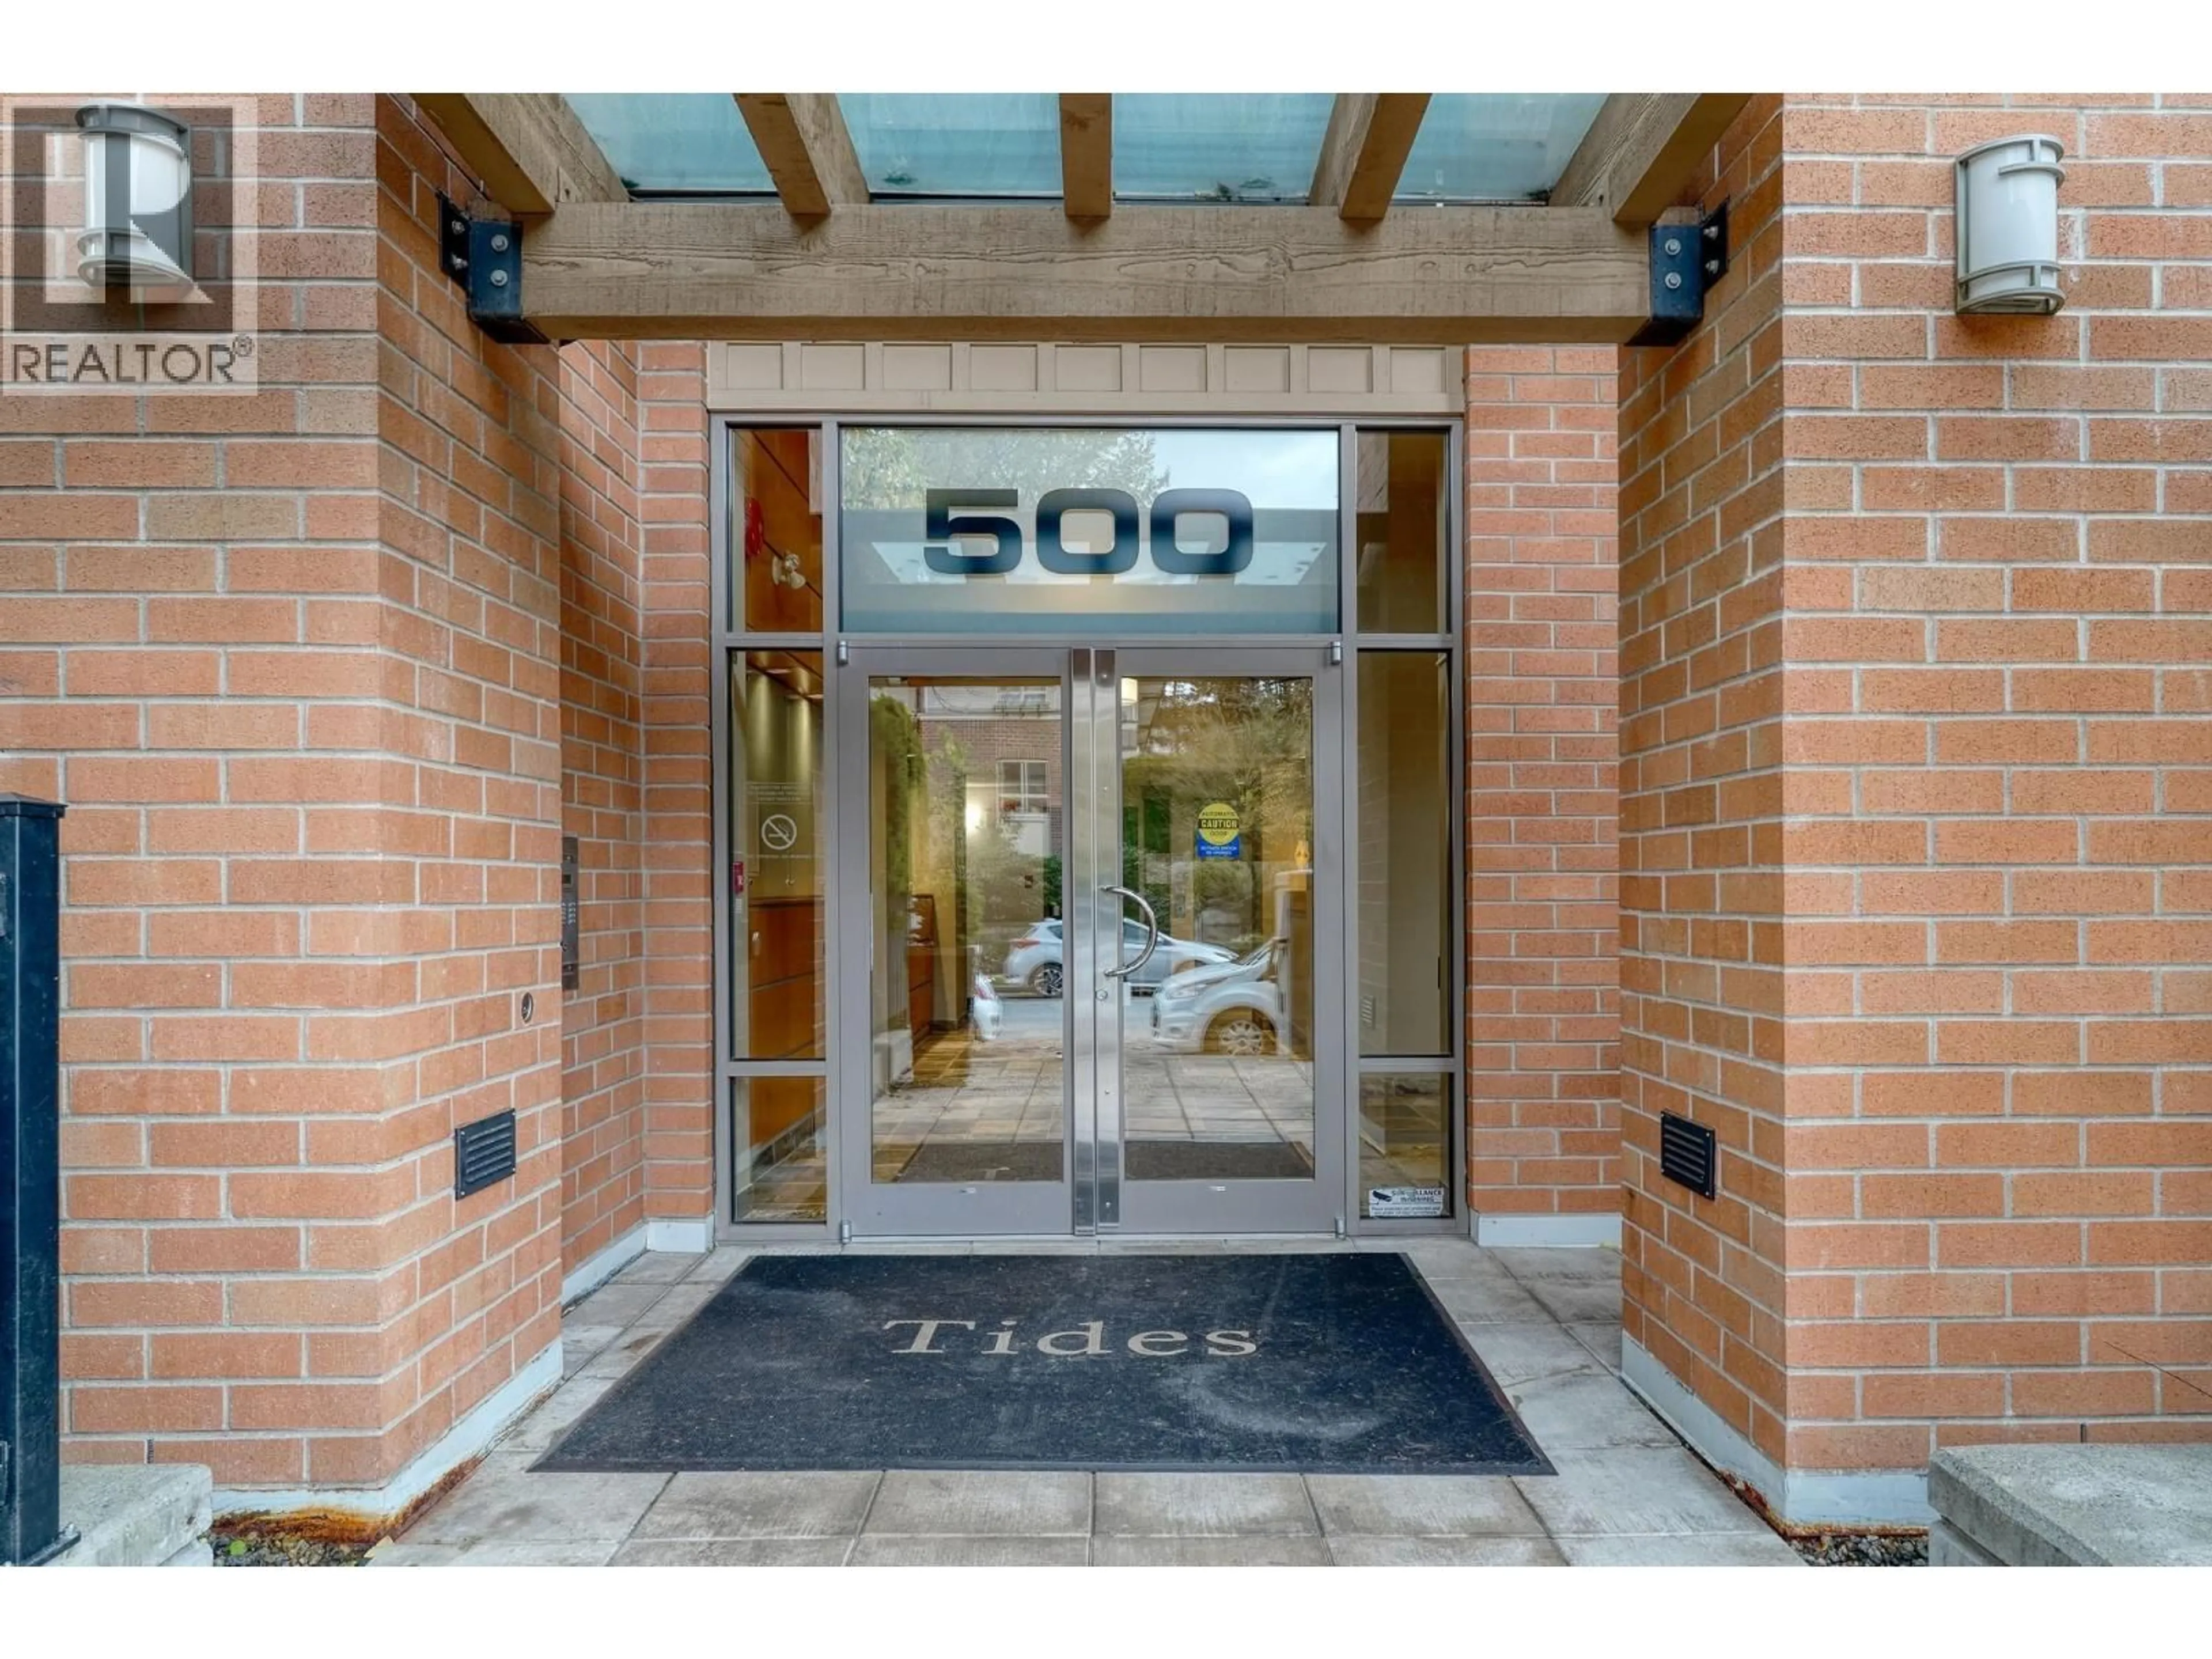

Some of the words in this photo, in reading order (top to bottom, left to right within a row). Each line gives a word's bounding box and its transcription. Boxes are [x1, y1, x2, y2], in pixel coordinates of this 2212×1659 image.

[923, 488, 1253, 574] 500
[1201, 819, 1237, 828] CAUTION
[882, 1320, 1258, 1356] Tides
